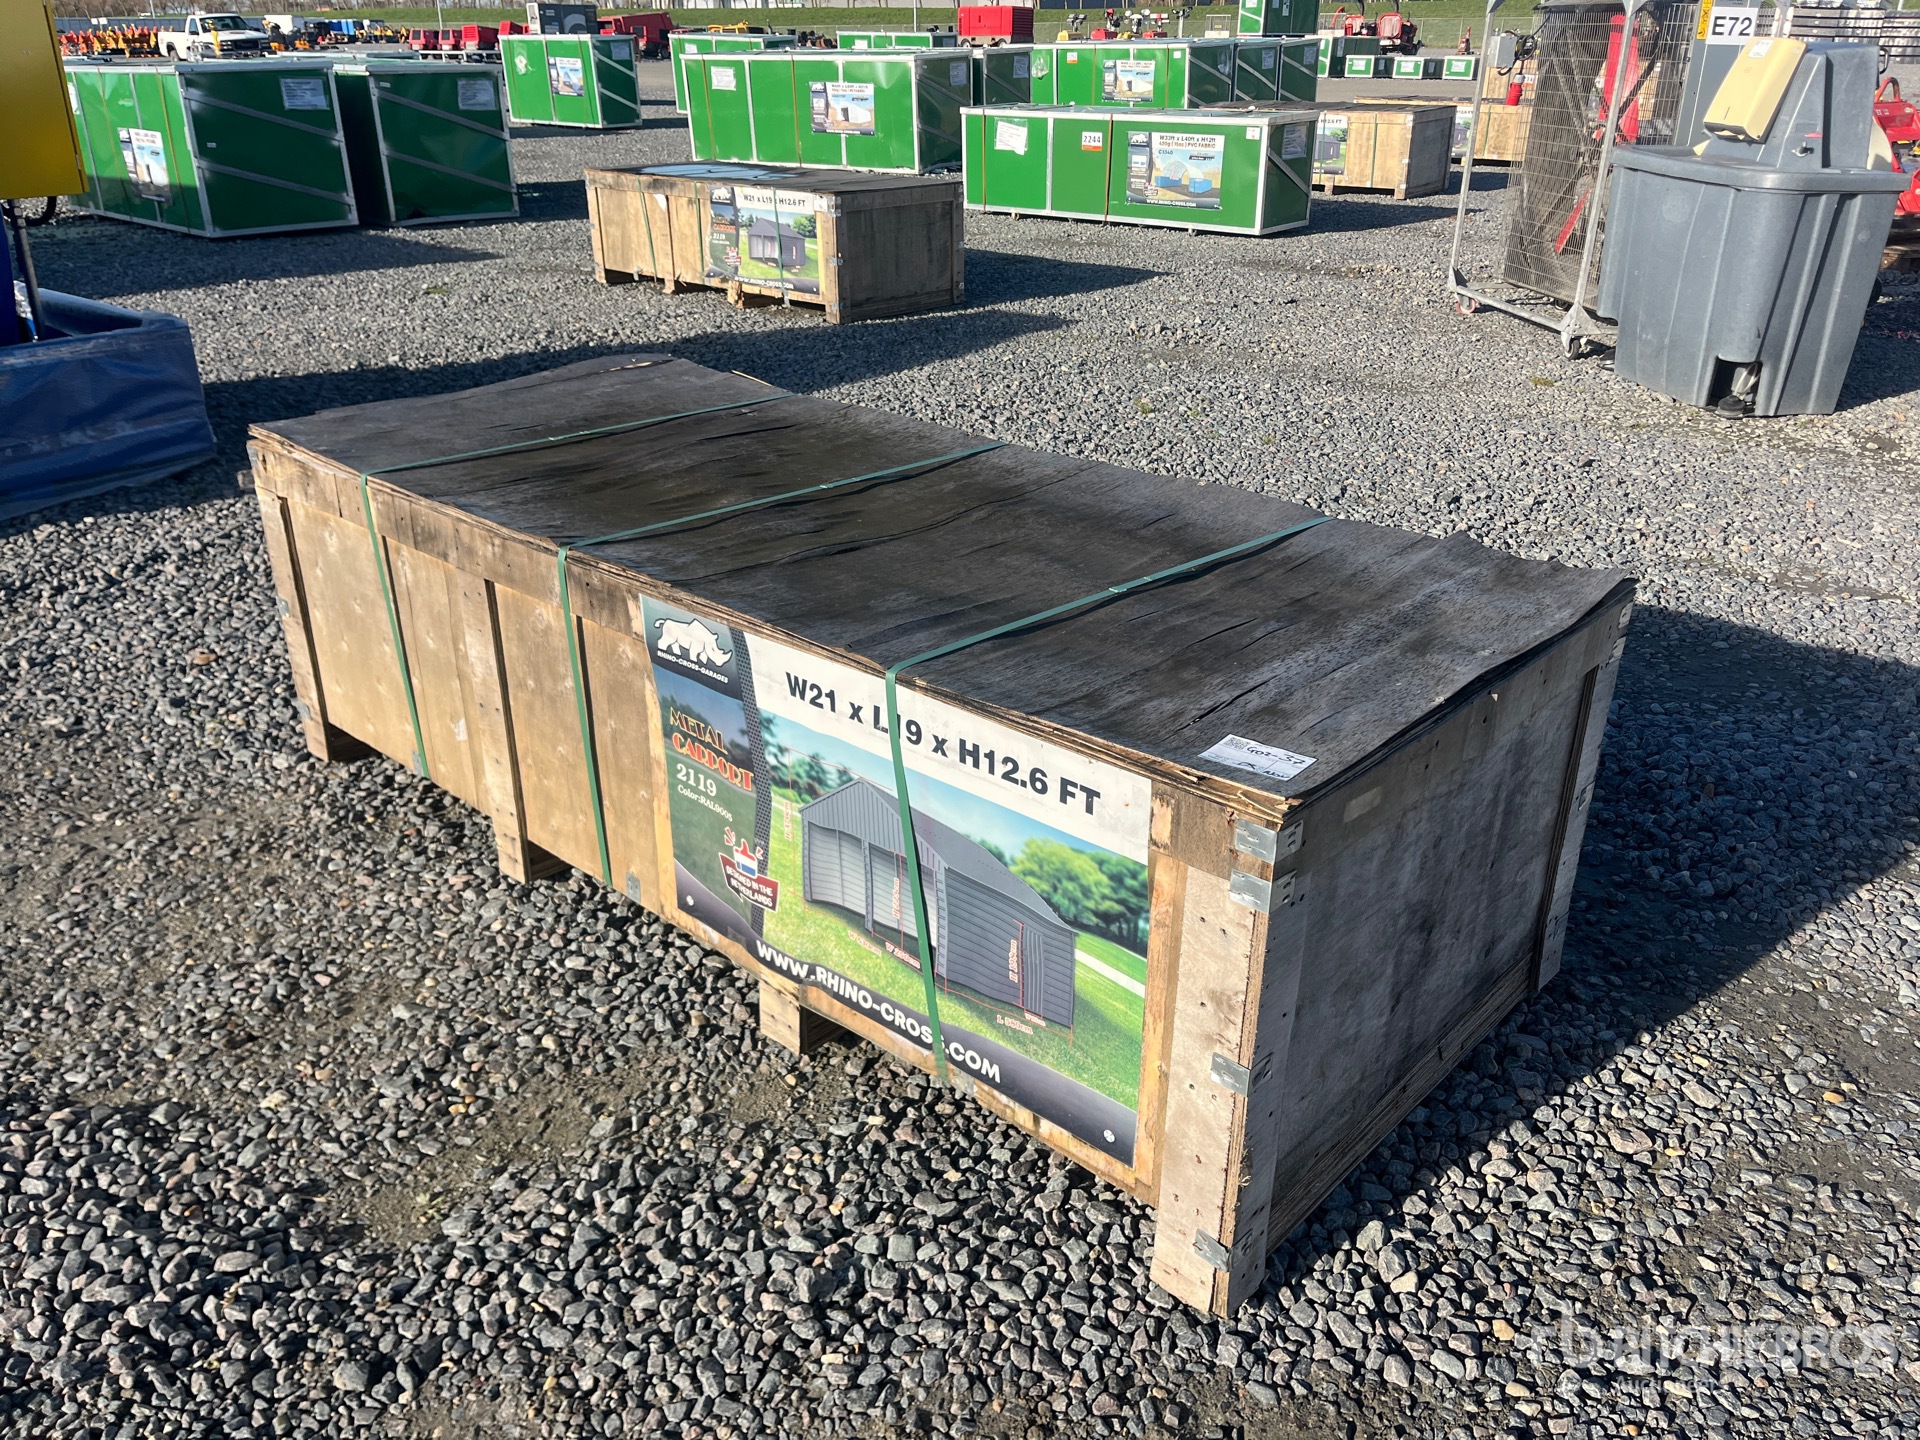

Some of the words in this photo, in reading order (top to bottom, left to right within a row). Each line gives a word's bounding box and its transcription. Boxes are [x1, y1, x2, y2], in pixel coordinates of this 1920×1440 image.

[1711, 15, 1752, 37] E72
[1083, 135, 1101, 143] 2244
[778, 198, 797, 206] H12.6
[797, 199, 806, 207] FT
[657, 650, 729, 684] RHINO-CROSS-GARAGES
[670, 706, 729, 755] METAL
[785, 671, 837, 714] W21
[849, 701, 864, 725] x
[932, 733, 949, 759] x
[959, 738, 1049, 796] H12.6
[1059, 776, 1101, 816] FT
[672, 732, 755, 792] CARPORT
[676, 763, 717, 797] 2119
[677, 784, 733, 822] Color:RAL9005
[756, 939, 1001, 1084] WWW.RHINO-CROS.COM
